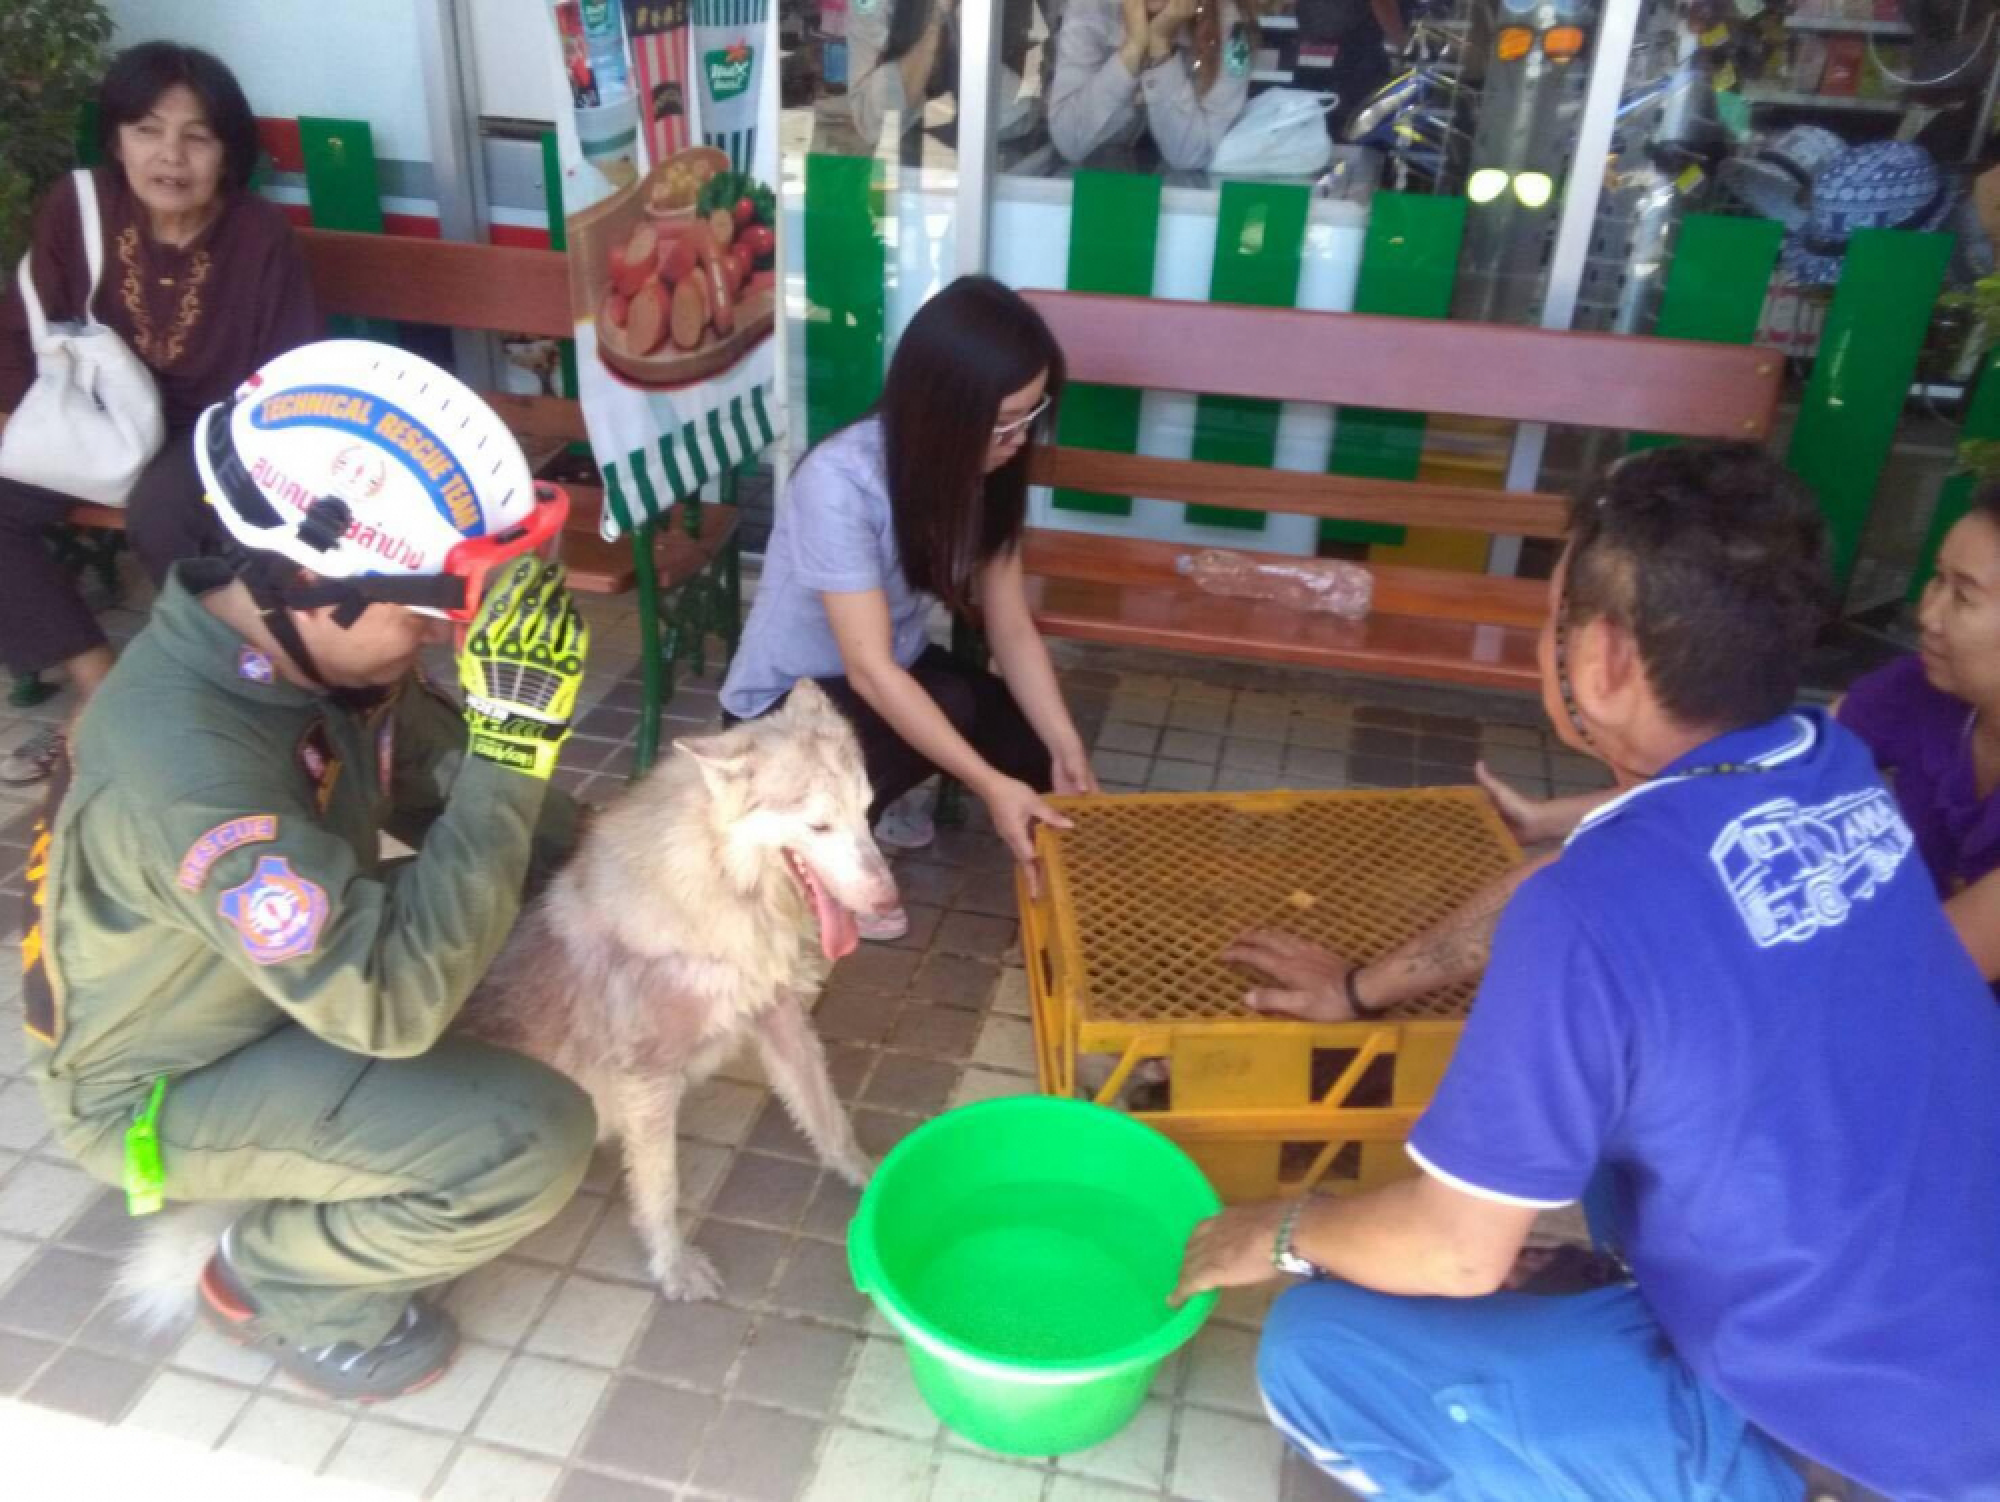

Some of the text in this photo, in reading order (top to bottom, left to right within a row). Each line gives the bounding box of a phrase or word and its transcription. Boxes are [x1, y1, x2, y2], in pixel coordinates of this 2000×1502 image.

[261, 394, 480, 532] TECHNICAL RESCUE TEAM
[180, 818, 276, 890] RESCUE
